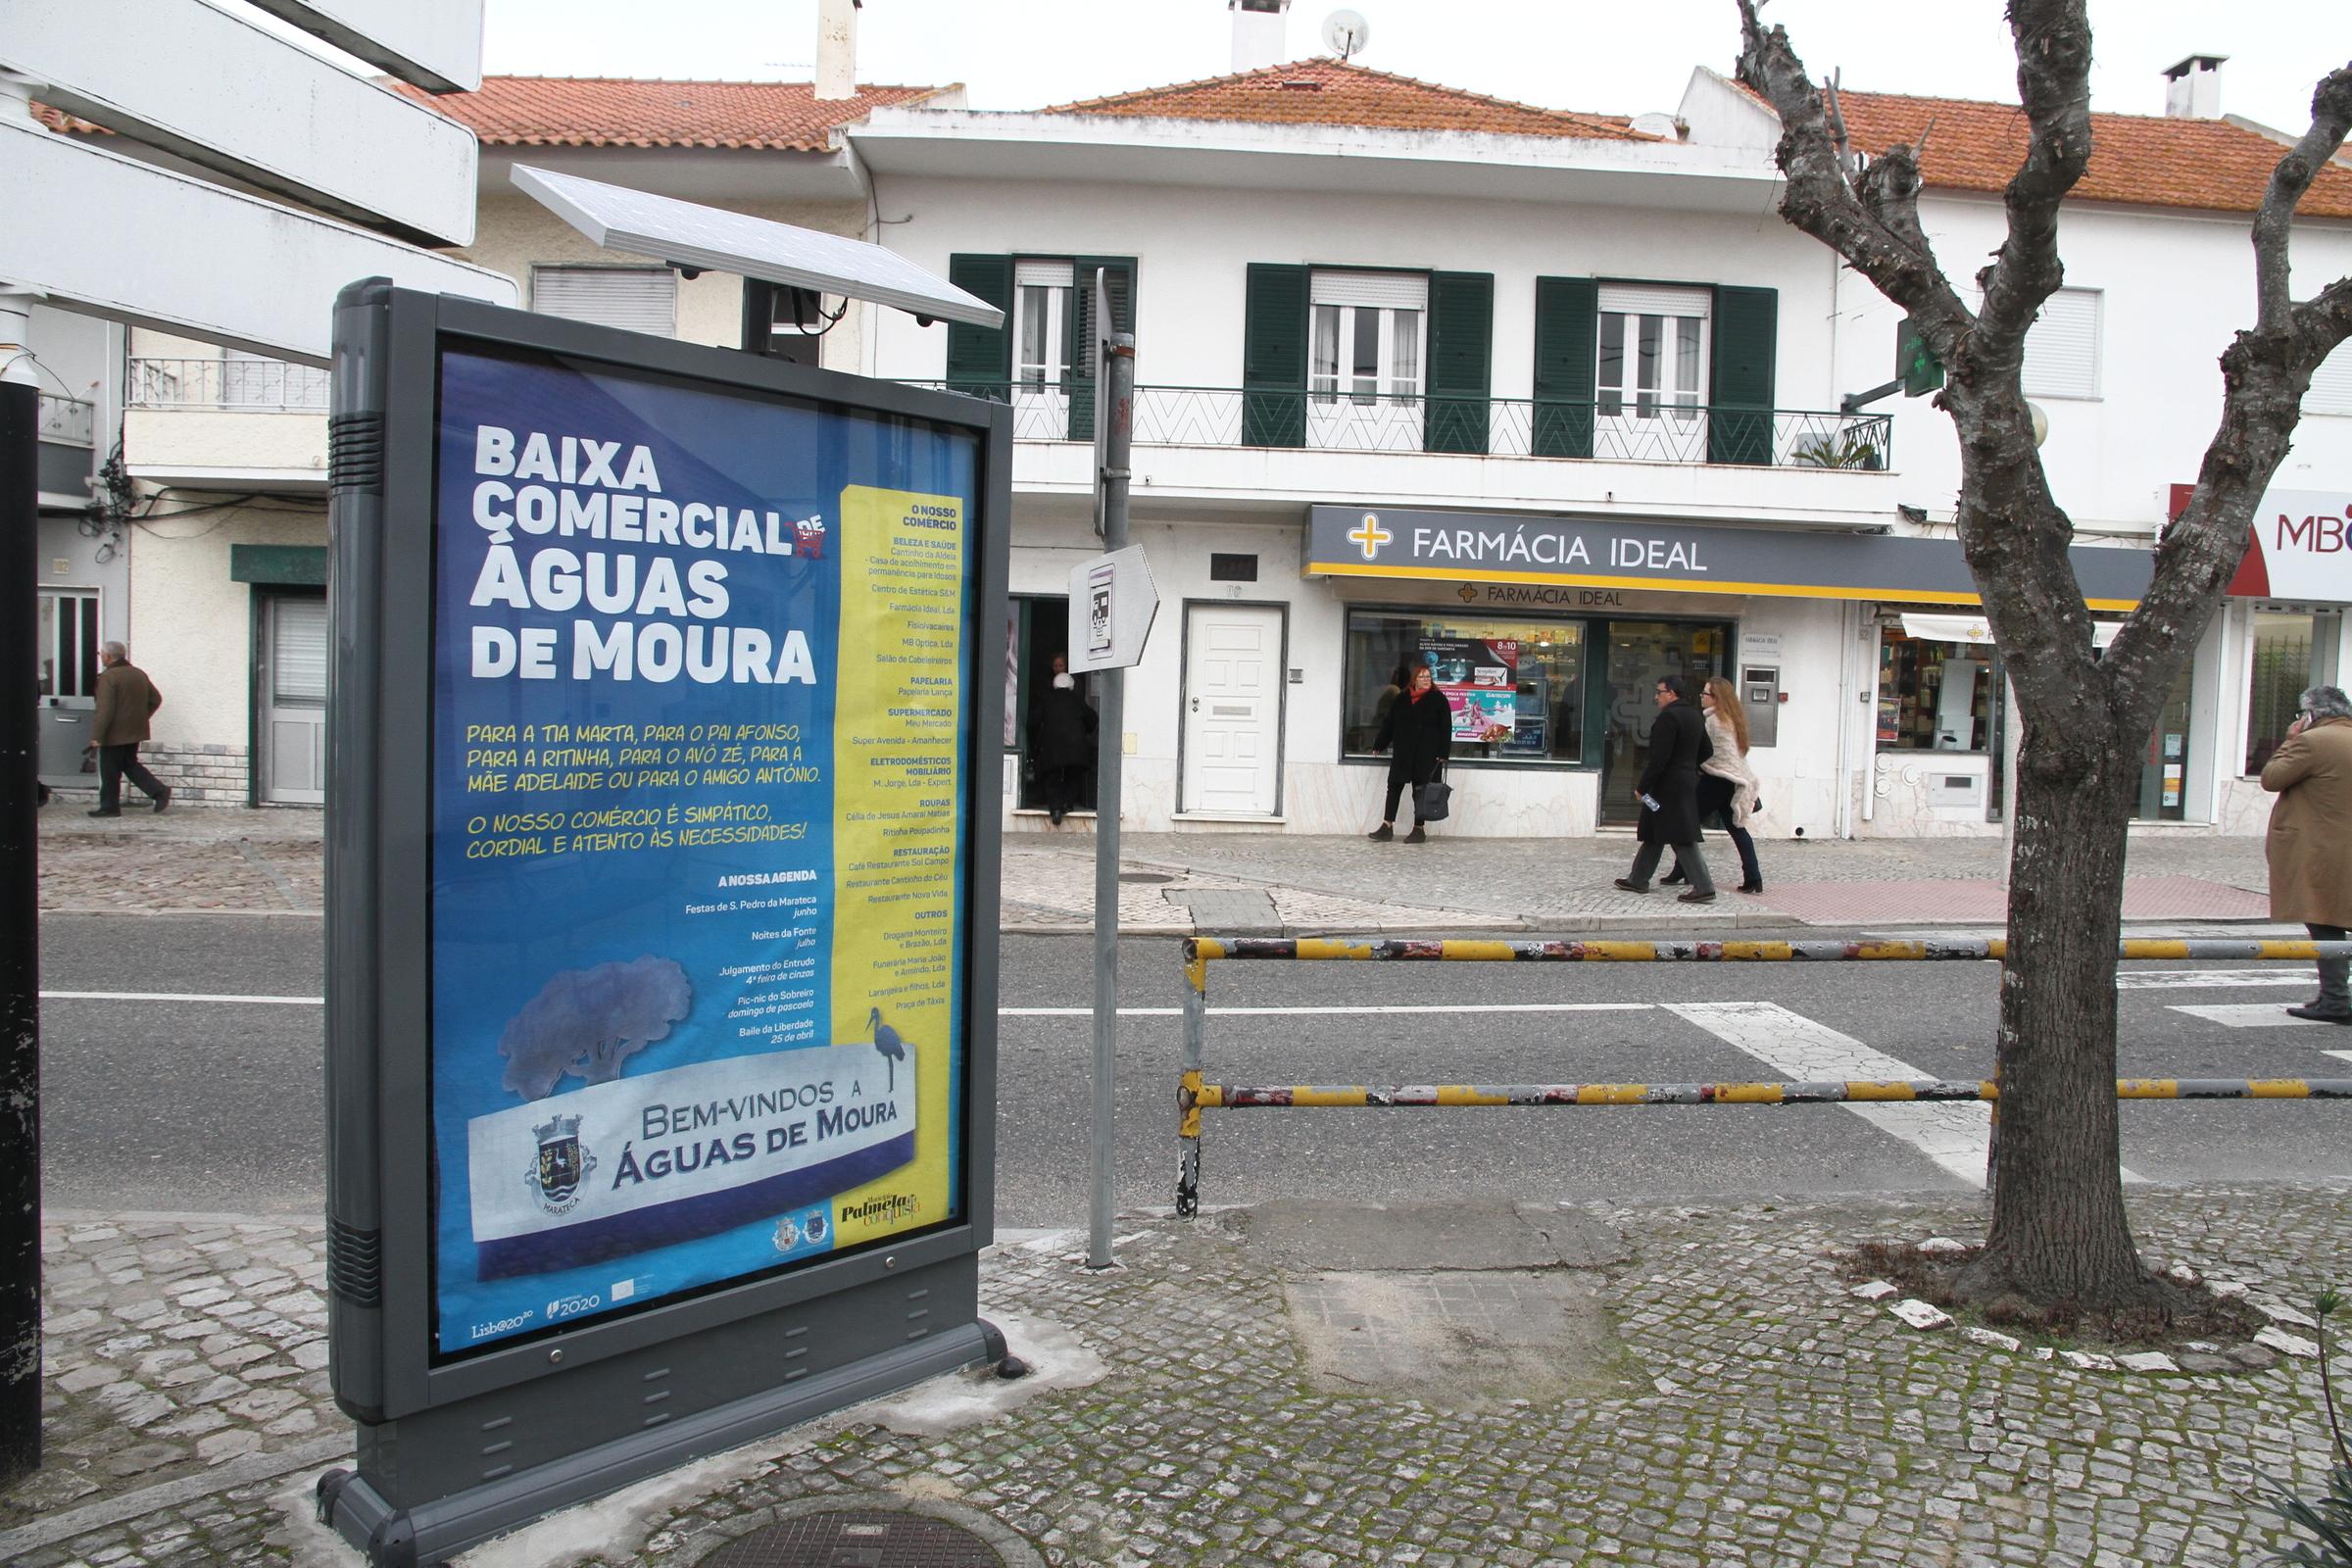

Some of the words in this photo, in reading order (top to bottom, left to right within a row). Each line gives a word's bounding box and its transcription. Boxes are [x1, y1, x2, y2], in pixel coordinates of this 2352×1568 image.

[475, 425, 662, 492] BAIXA
[472, 481, 792, 556] COMERCIAL
[912, 505, 919, 514] O
[921, 505, 956, 518] NOSSO
[903, 516, 956, 530] COMÉRCIO
[894, 537, 923, 547] BELEZA
[2277, 514, 2352, 553] MB
[1414, 524, 1591, 564] FARMÁCIA
[1611, 538, 1707, 571] IDEAL
[470, 528, 729, 618] ÁGUAS
[1488, 585, 1570, 605] FARMÁCIA
[1579, 591, 1622, 607] IDEAL
[471, 626, 557, 679] DE
[573, 620, 816, 684] MOURA
[888, 708, 952, 717] SUPERMERCADO
[467, 725, 515, 743] PARA
[523, 725, 535, 742] A
[542, 725, 569, 742] TIA
[576, 725, 638, 745] MARTA,
[643, 725, 685, 741] PARA
[690, 725, 703, 741] O
[708, 725, 731, 741] PAI
[735, 724, 801, 743] AFONSO,
[467, 749, 517, 767] PARA
[524, 749, 536, 767] A
[543, 748, 613, 768] RITINHA,
[619, 748, 661, 765] PARA
[667, 748, 680, 764] O
[685, 743, 716, 763] AVÔ
[721, 742, 746, 765] ZÉ,
[751, 746, 787, 762] PARA
[793, 746, 802, 761] A
[871, 756, 951, 765] ELETRODOMÉSTICOS
[468, 770, 508, 792] MÃE
[514, 772, 604, 791] ADELAIDE
[609, 771, 633, 788] OU
[638, 770, 679, 787] PARA
[685, 770, 698, 785] O
[703, 768, 750, 784] AMIGO
[756, 763, 821, 784] ANTÓNIO.
[906, 766, 951, 775] MOBILIÁRIO
[468, 816, 486, 833] O
[493, 813, 565, 833] NOSSO
[571, 806, 661, 829] COMÉRCIO
[667, 803, 679, 824] É
[685, 801, 772, 824] SIMPÁTICO,
[467, 837, 546, 858] CORDIAL
[554, 836, 566, 853] E
[572, 832, 644, 852] ATENTO
[650, 827, 674, 847] ÀS
[679, 822, 808, 847] NECESSIDADES!
[893, 845, 950, 857] RESTAURAÇÃO
[718, 876, 727, 887] A
[729, 873, 771, 886] NOSSA
[772, 870, 817, 882] AGENDA
[686, 904, 715, 914] Festas
[740, 900, 765, 909] Pedro
[768, 898, 777, 907] da
[780, 896, 816, 906] Marateca
[793, 907, 817, 919] junho
[915, 910, 947, 919] OUTROS
[752, 930, 779, 940] Noites
[781, 929, 791, 937] da
[794, 927, 816, 936] Fonte
[796, 938, 815, 949] julho
[719, 964, 770, 976] Julgamento
[772, 961, 781, 970] do
[784, 957, 814, 968] Entrudo
[789, 970, 814, 979] cinzas
[738, 995, 766, 1005] Pic-nic
[768, 993, 778, 1001] do
[781, 989, 814, 1000] Sobreiro
[728, 1006, 764, 1018] domingo
[766, 1004, 776, 1012] de
[739, 1025, 760, 1037] Baile
[762, 1024, 772, 1034] da
[774, 1019, 813, 1032] Liberdade
[771, 1035, 782, 1043] 25
[797, 1030, 813, 1039] abril
[612, 1132, 757, 1191] ÁGUAS
[766, 1121, 807, 1154] DE
[816, 1101, 897, 1143] MOURA
[842, 1195, 907, 1223] Palmela
[560, 1295, 599, 1317] 2020
